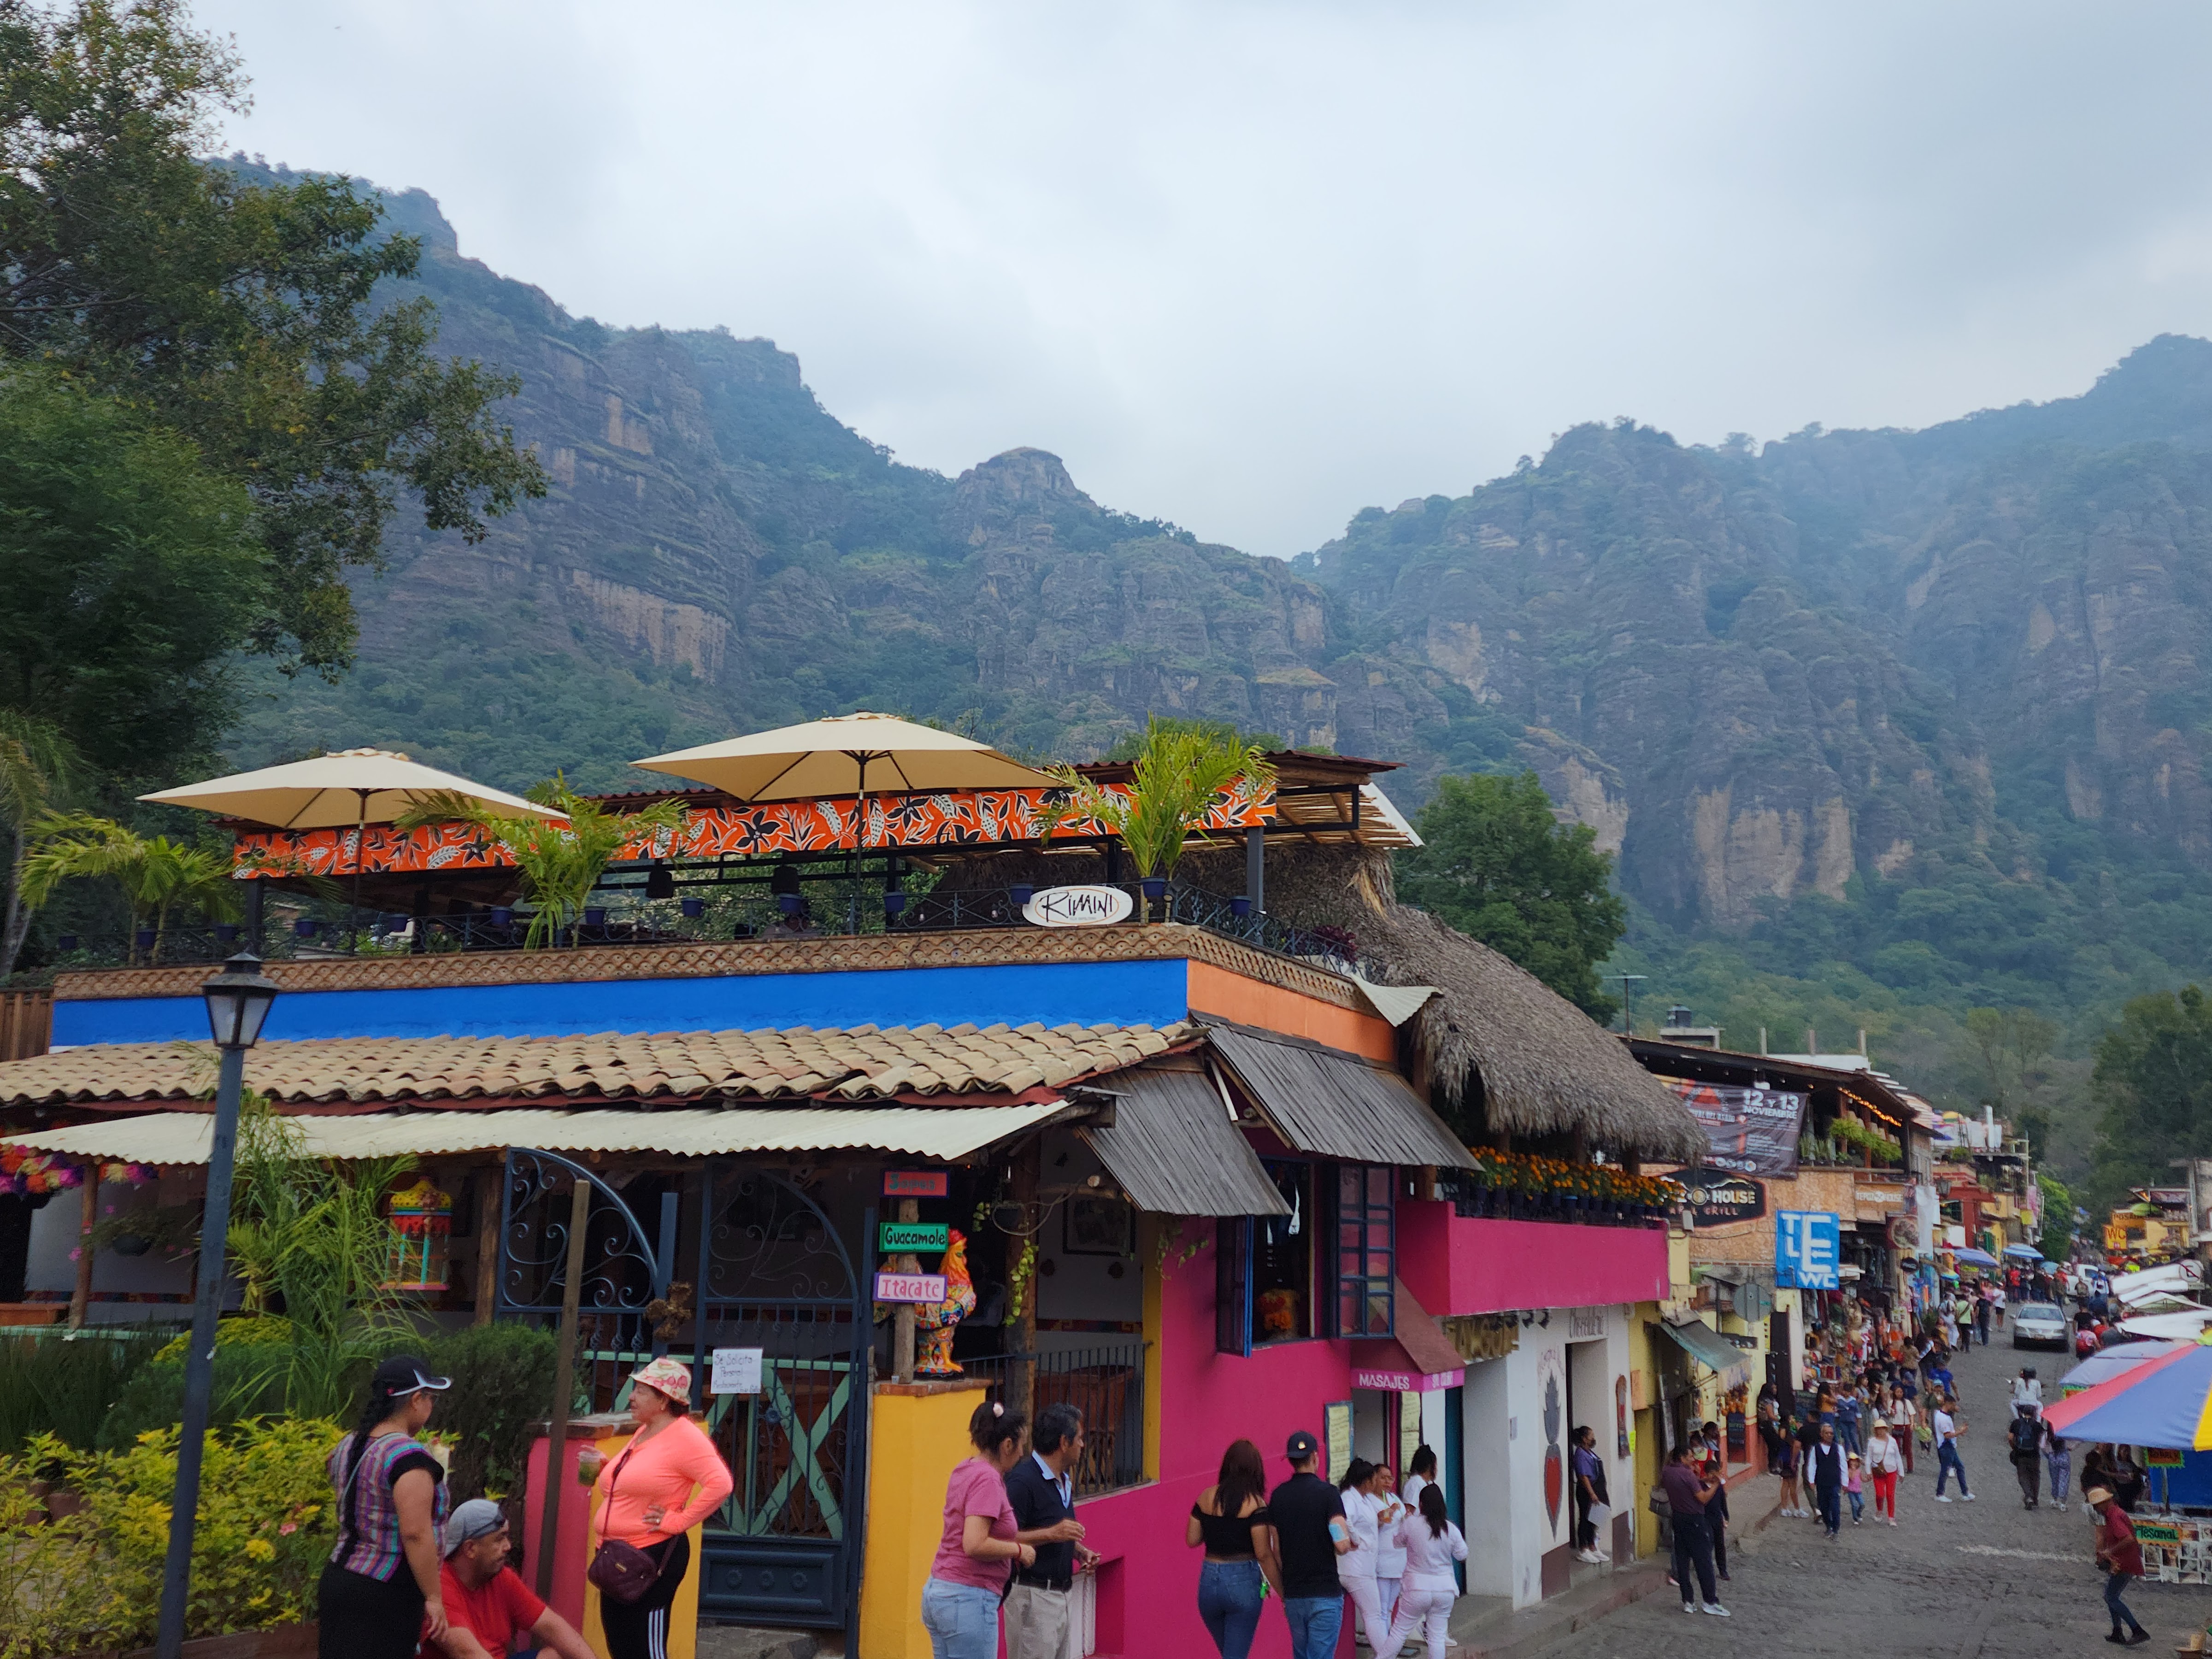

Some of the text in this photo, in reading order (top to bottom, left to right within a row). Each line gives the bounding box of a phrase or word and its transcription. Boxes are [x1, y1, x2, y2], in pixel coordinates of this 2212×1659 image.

[1743, 1089, 1764, 1106] 12
[1780, 1094, 1800, 1111] 13
[1743, 1105, 1797, 1119] NOVIEMBRE
[889, 1173, 935, 1193] Sopes
[1712, 1190, 1756, 1204] HOUSE
[885, 1227, 945, 1245] Guacamole
[2106, 1227, 2127, 1240] WC
[1799, 1272, 1836, 1288] WC
[882, 1279, 940, 1299] Itacate
[715, 1354, 723, 1366] Se
[1359, 1374, 1410, 1390] MASAJES
